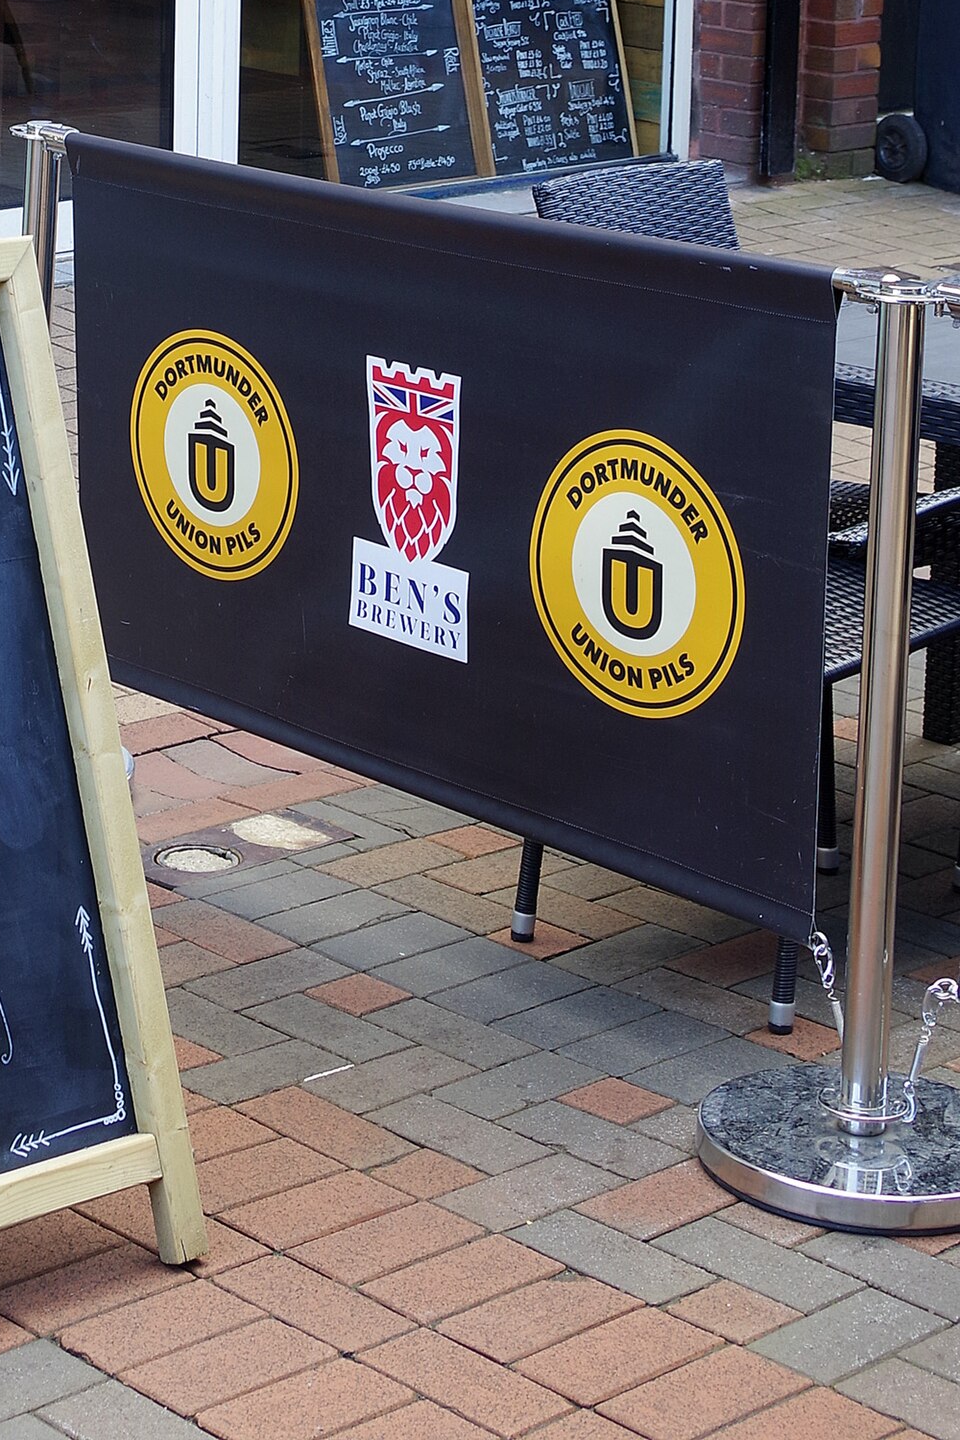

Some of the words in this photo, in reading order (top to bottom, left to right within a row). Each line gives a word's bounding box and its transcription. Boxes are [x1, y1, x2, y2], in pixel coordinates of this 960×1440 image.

[153, 354, 269, 427] DORTMUNDER
[191, 438, 232, 508] U
[565, 458, 709, 545] DORTMUNDER
[164, 498, 222, 555] UNION
[225, 522, 262, 557] PILS
[356, 600, 462, 651] BREWERY
[358, 562, 462, 626] BEN'S
[606, 553, 658, 634] U
[571, 622, 643, 691] UNION
[648, 653, 695, 691] PILS
